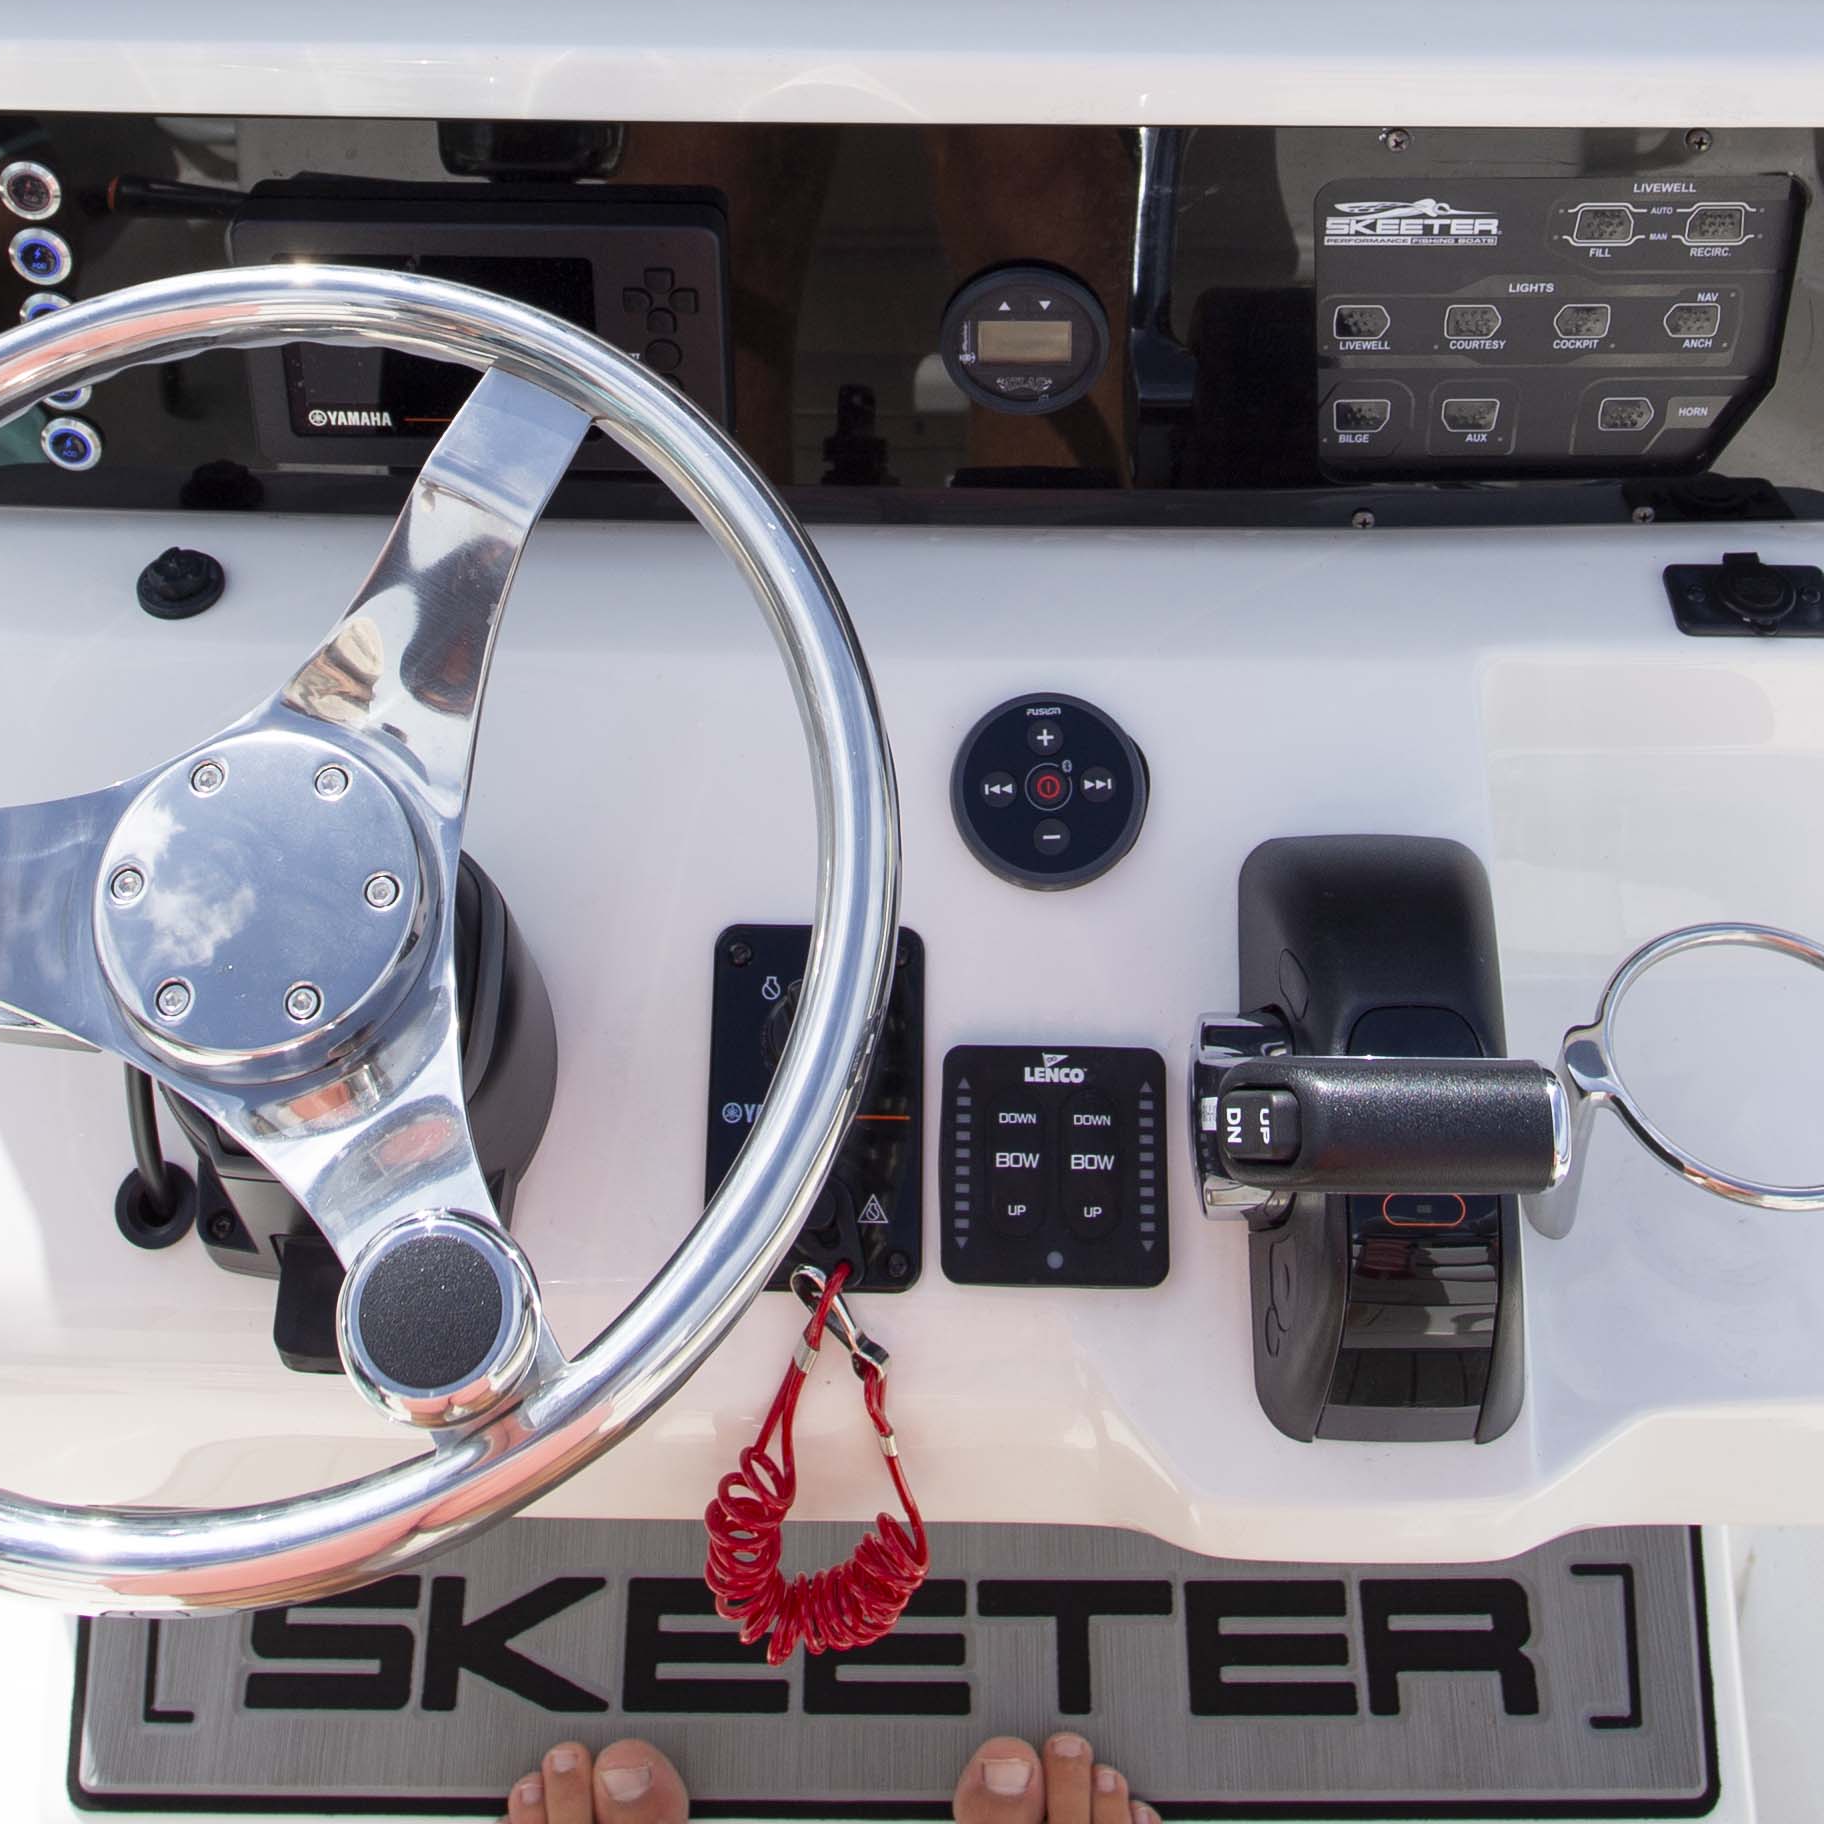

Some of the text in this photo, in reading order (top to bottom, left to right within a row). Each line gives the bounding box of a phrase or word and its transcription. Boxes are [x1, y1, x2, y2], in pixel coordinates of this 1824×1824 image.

[1633, 182, 1697, 194] LIVEWELL
[1650, 206, 1673, 216] AUTO
[1325, 217, 1499, 235] SKEETER
[1649, 233, 1668, 241] MAN
[1588, 247, 1612, 258] FILL
[1689, 247, 1732, 258] RECIRC.
[1508, 282, 1555, 295] LIGHTS
[1697, 292, 1719, 302] NAV
[1339, 340, 1391, 351] LIVEWELL
[1449, 339, 1506, 351] COURTESY
[1553, 338, 1600, 350] COCKPIT
[1682, 338, 1713, 350] ANCH
[1678, 406, 1709, 417] HORN
[327, 410, 392, 427] YAMAHA
[1338, 433, 1370, 444] BILGE
[1465, 432, 1488, 443] AUX
[1023, 1066, 1085, 1084] LENCO
[998, 1112, 1037, 1125] DOWN
[1073, 1114, 1111, 1127] DOWN
[1226, 1107, 1243, 1144] DN
[1259, 1108, 1271, 1145] UP
[995, 1152, 1040, 1170] BOW
[1070, 1153, 1115, 1171] BOW
[1007, 1204, 1026, 1217] UP
[1083, 1206, 1102, 1219] UP
[244, 1575, 1540, 1717] SKEETER
